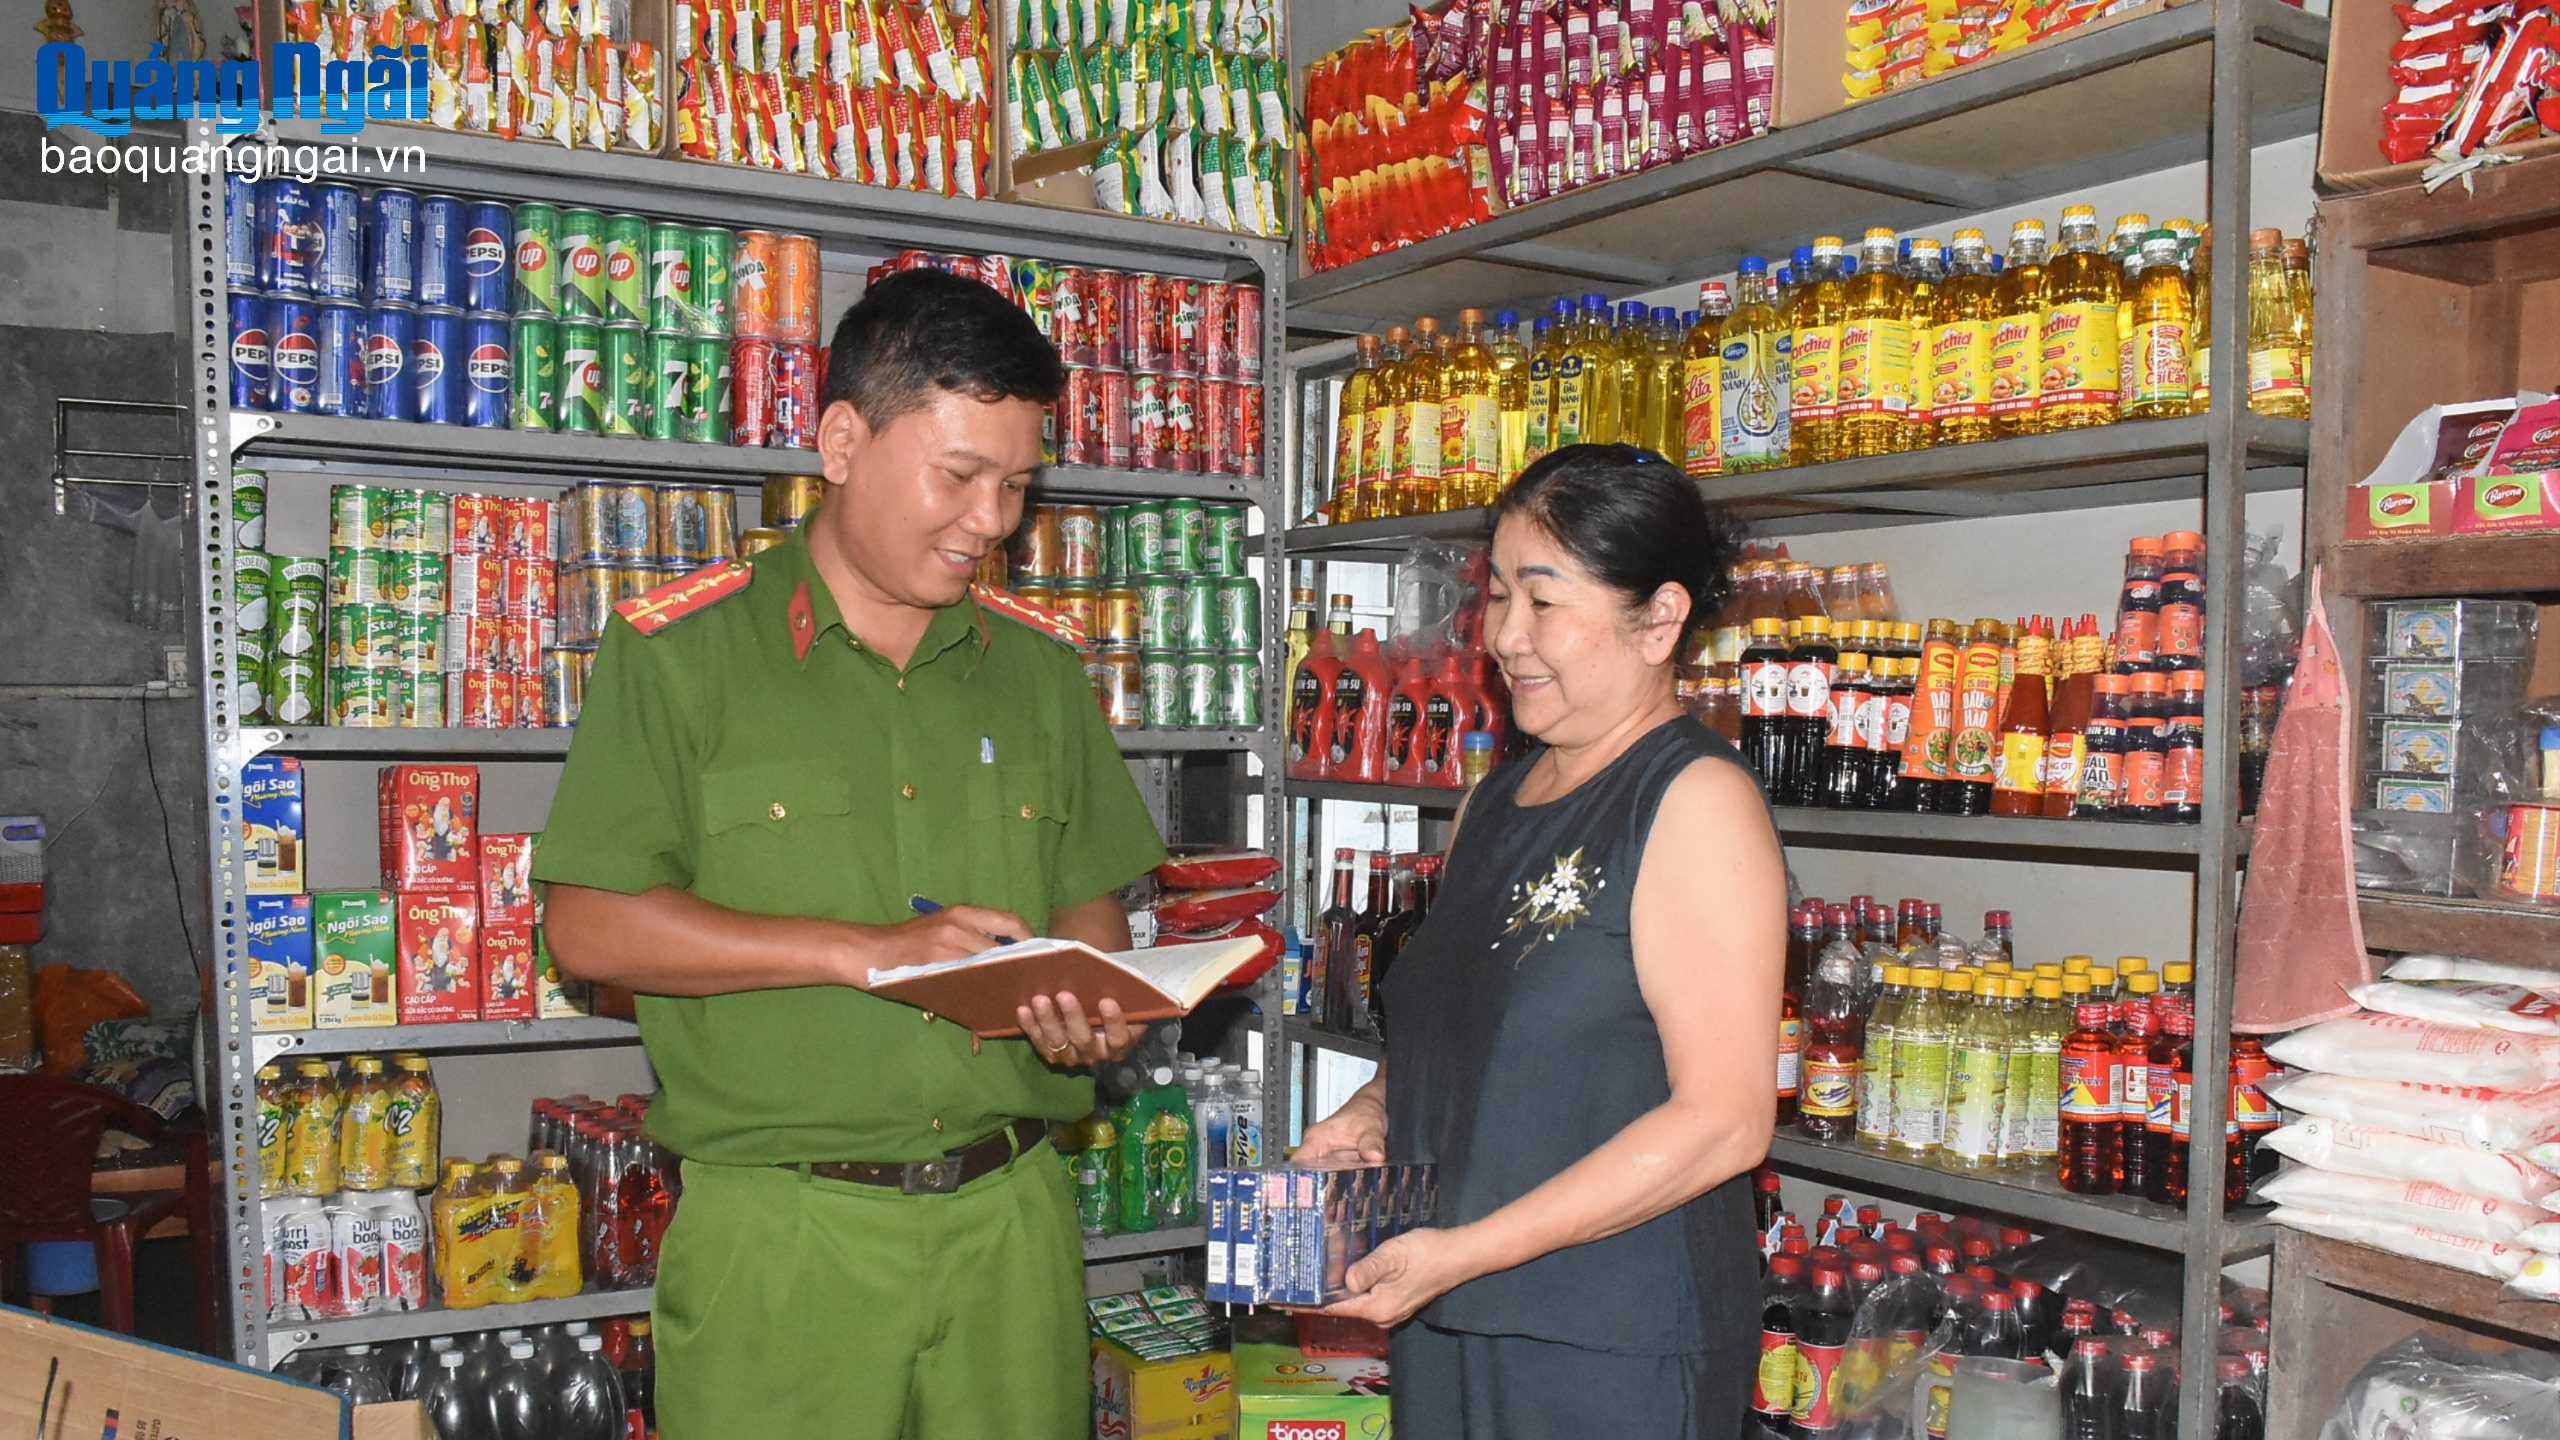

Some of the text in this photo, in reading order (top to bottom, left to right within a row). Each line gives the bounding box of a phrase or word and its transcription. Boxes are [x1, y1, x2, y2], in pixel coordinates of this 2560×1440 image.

[236, 346, 268, 360] PEP
[1724, 345, 1747, 358] Simply
[276, 352, 317, 367] PEPS
[367, 352, 400, 366] EPSI
[417, 358, 440, 368] PSI
[470, 361, 508, 374] PEPS
[2486, 487, 2522, 504] Barona
[2381, 495, 2414, 512] Barona
[407, 563, 439, 578] Star
[1296, 679, 1317, 690] HIN-SU
[1390, 702, 1412, 712] HIN-SU
[243, 778, 296, 797] gôi Sao
[408, 771, 470, 792] Ông Thọ
[486, 844, 507, 858] Ông
[280, 915, 306, 927] Sao
[408, 905, 440, 925] Ông
[327, 915, 388, 937] Ngôi Sao
[486, 937, 527, 950] Ông Thọ
